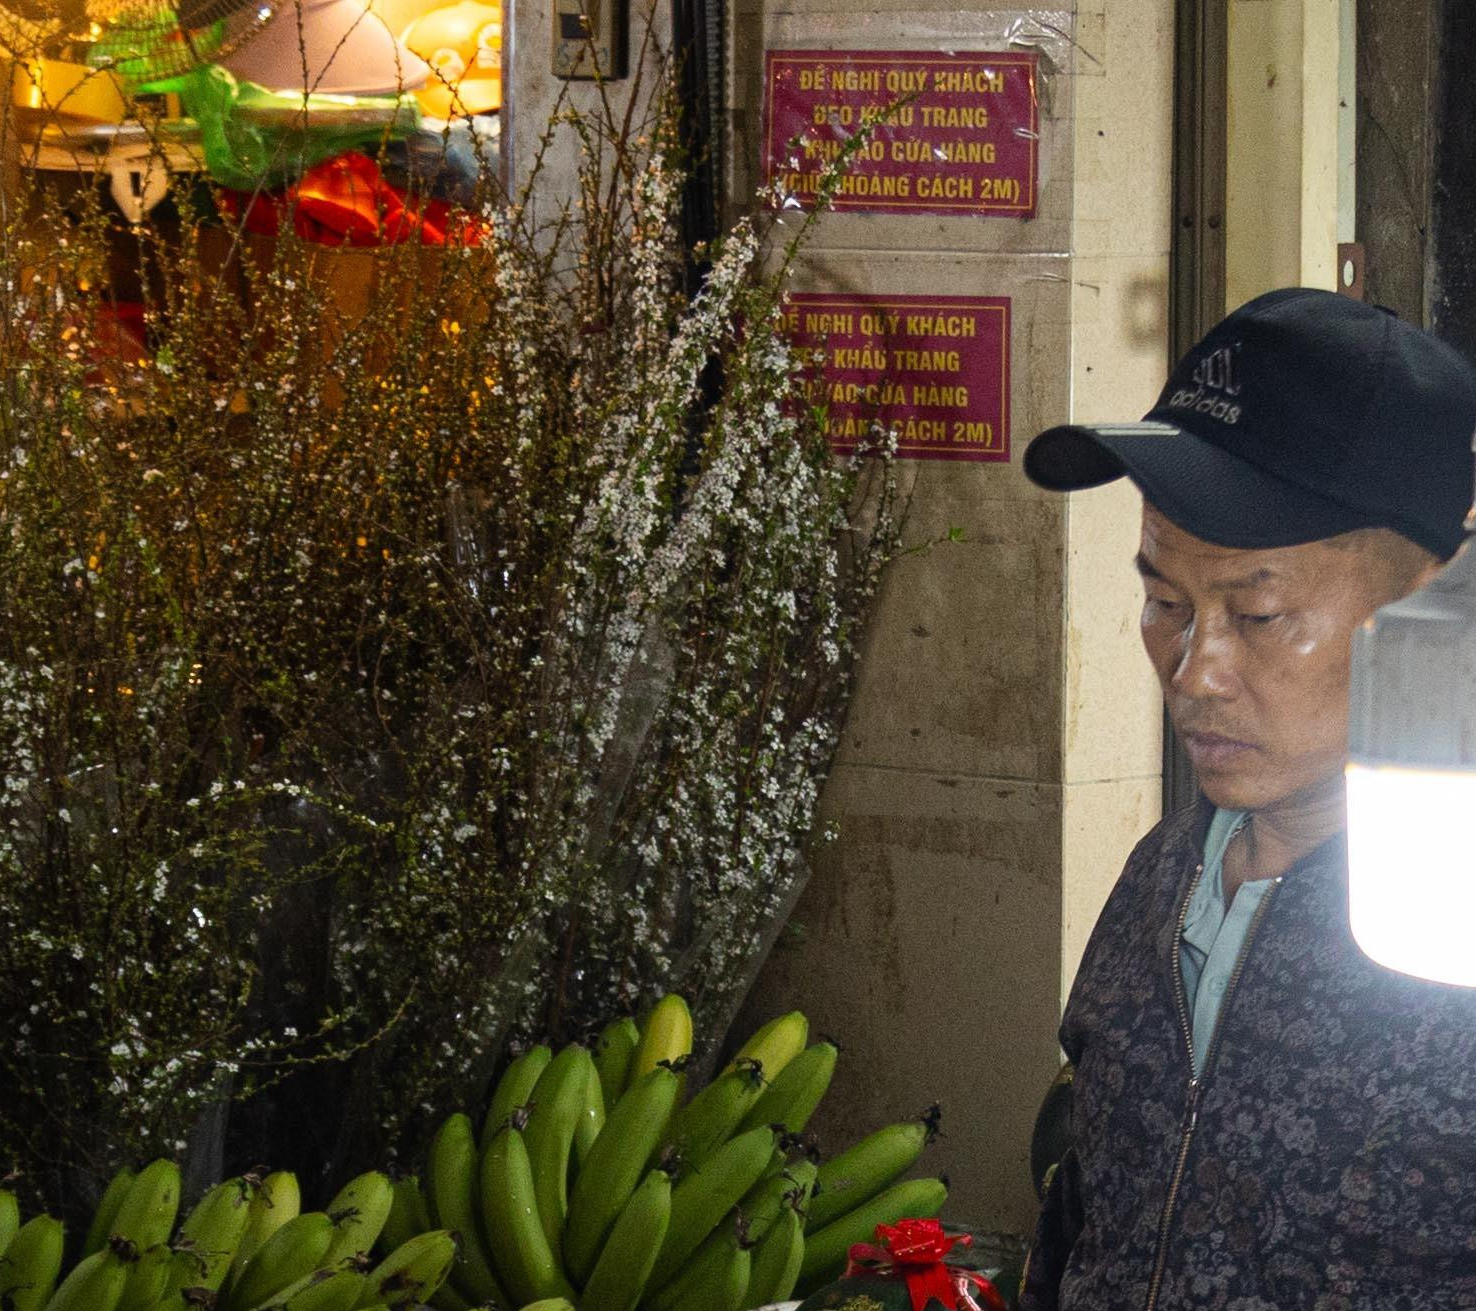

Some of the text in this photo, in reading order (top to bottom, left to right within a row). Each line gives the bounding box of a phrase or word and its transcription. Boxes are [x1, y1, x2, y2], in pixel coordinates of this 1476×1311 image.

[832, 70, 880, 95] NGHỊ
[886, 67, 927, 92] QUÝ
[934, 67, 1005, 93] KHÁCH
[921, 106, 988, 128] TRANG
[940, 137, 995, 164] HÀNG
[834, 171, 910, 197] HOẢNG
[917, 172, 973, 198] CÁCH
[980, 178, 1021, 203] 2M)
[806, 313, 854, 338] NGHỊ
[907, 311, 976, 337] KHÁCH
[834, 340, 887, 371] KHẨU
[894, 350, 960, 372] TRANG
[913, 380, 969, 408] HÀNG
[1168, 384, 1241, 425] adidas
[953, 422, 993, 447] 2M)
